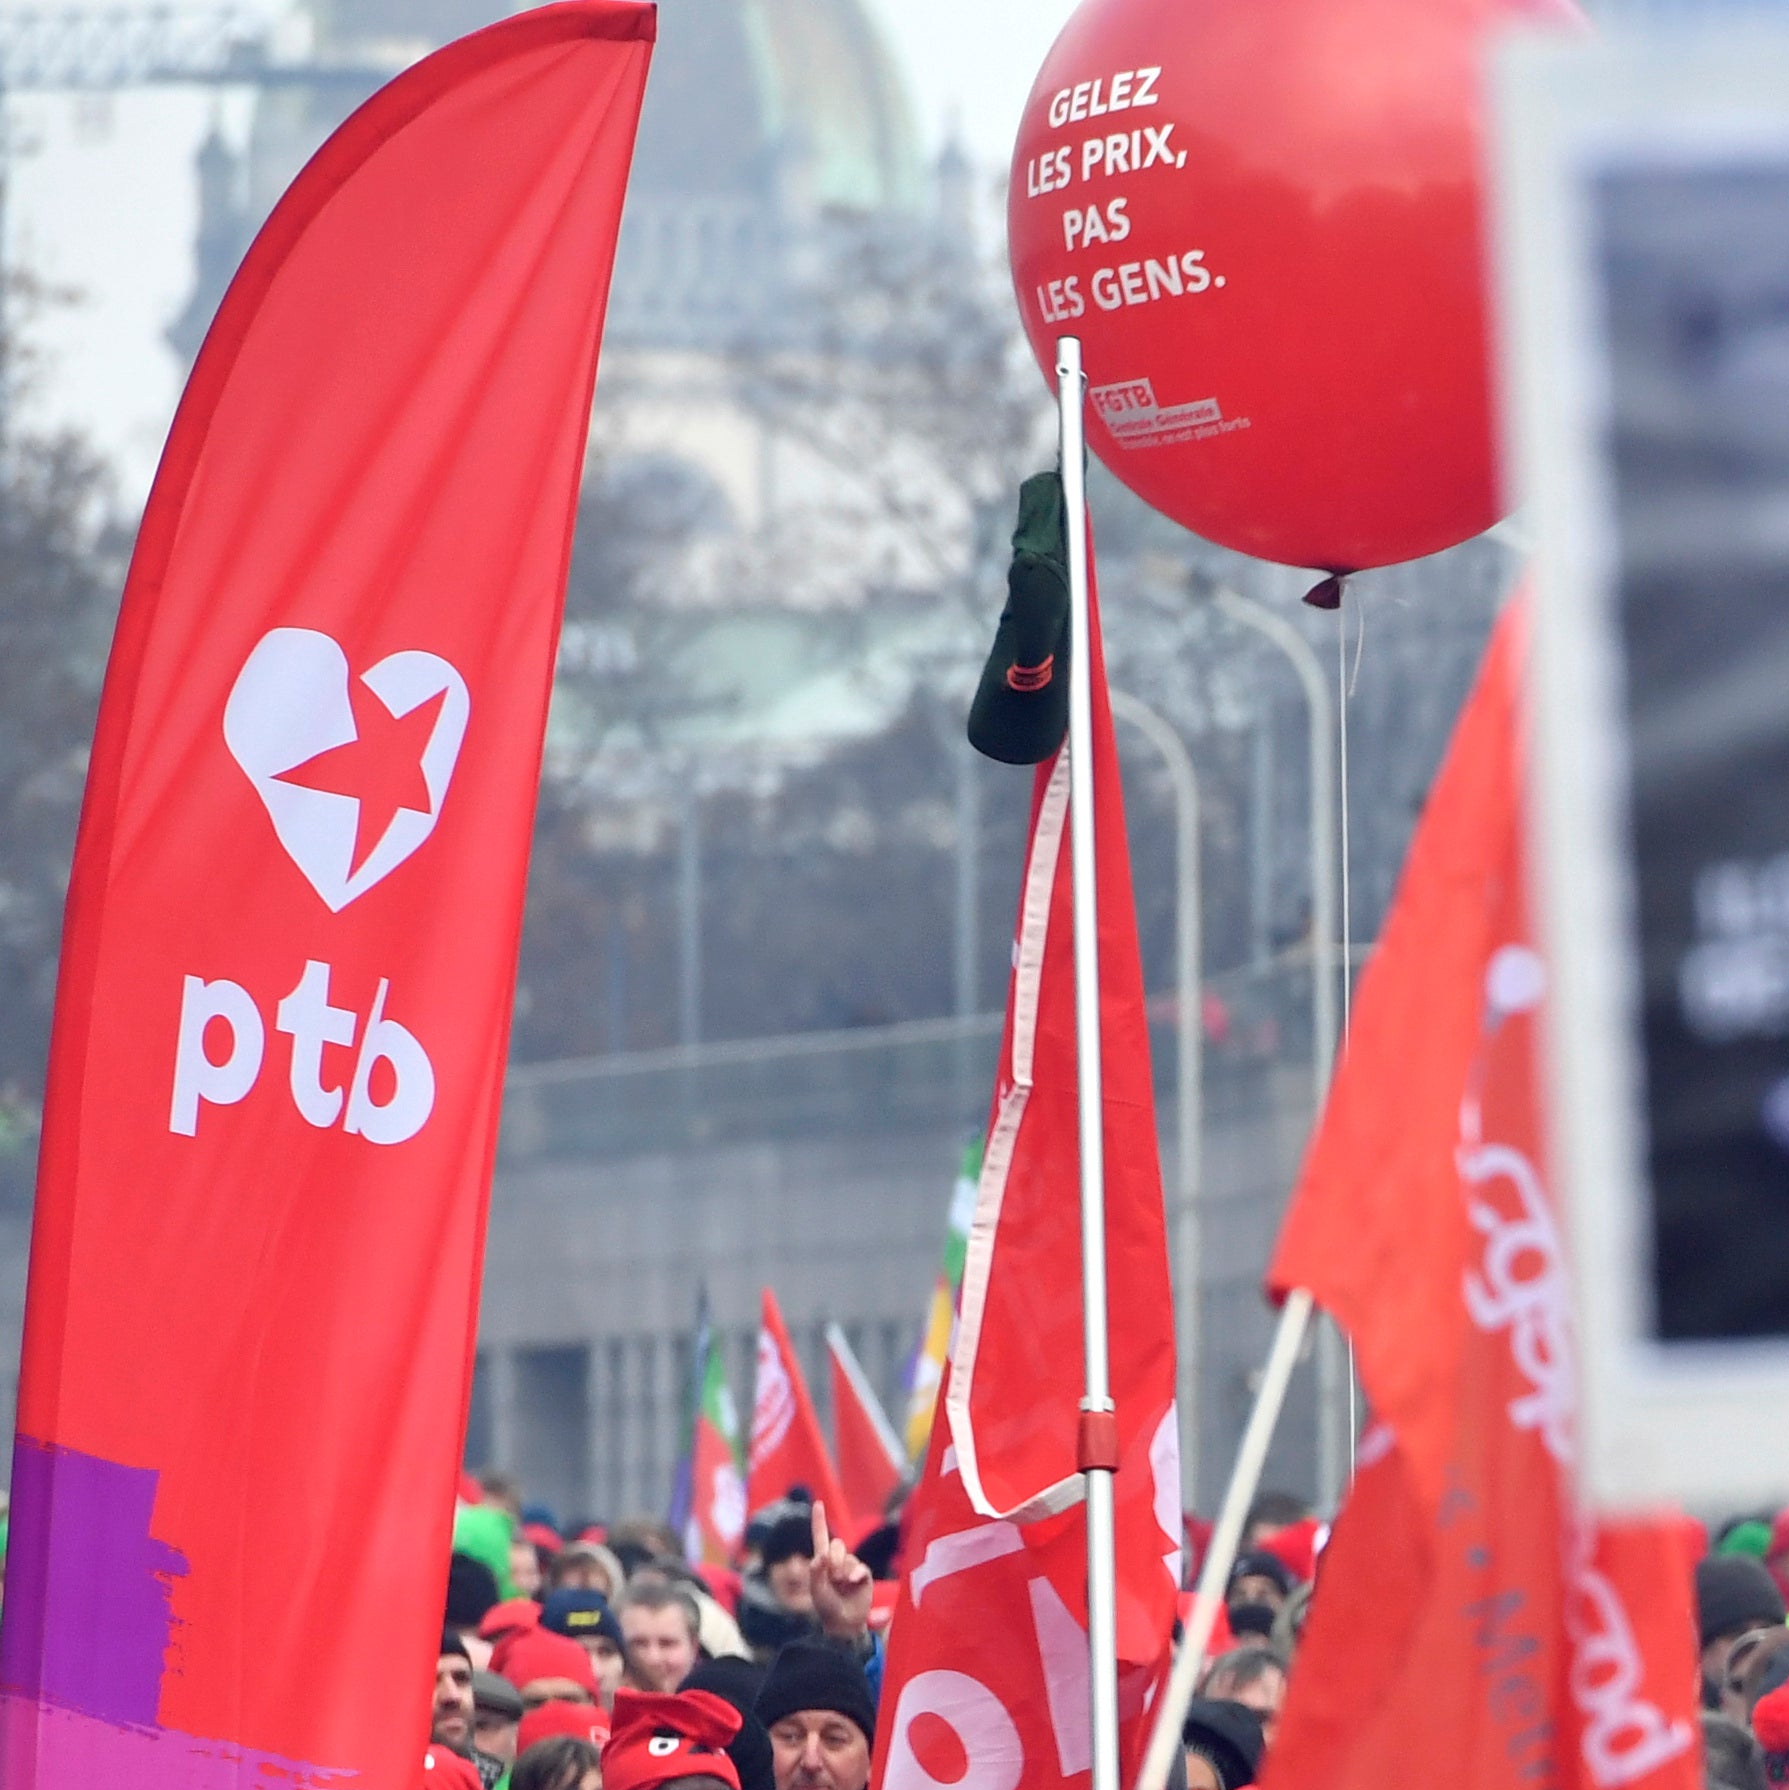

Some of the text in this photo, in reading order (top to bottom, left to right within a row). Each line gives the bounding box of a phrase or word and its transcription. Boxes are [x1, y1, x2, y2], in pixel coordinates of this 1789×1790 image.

[1049, 67, 1162, 129] GELEZ
[1028, 123, 1188, 199] LES PRIX,
[1063, 198, 1131, 252] PAS
[1037, 250, 1226, 324] LES GENS.
[169, 959, 436, 1146] ptb
